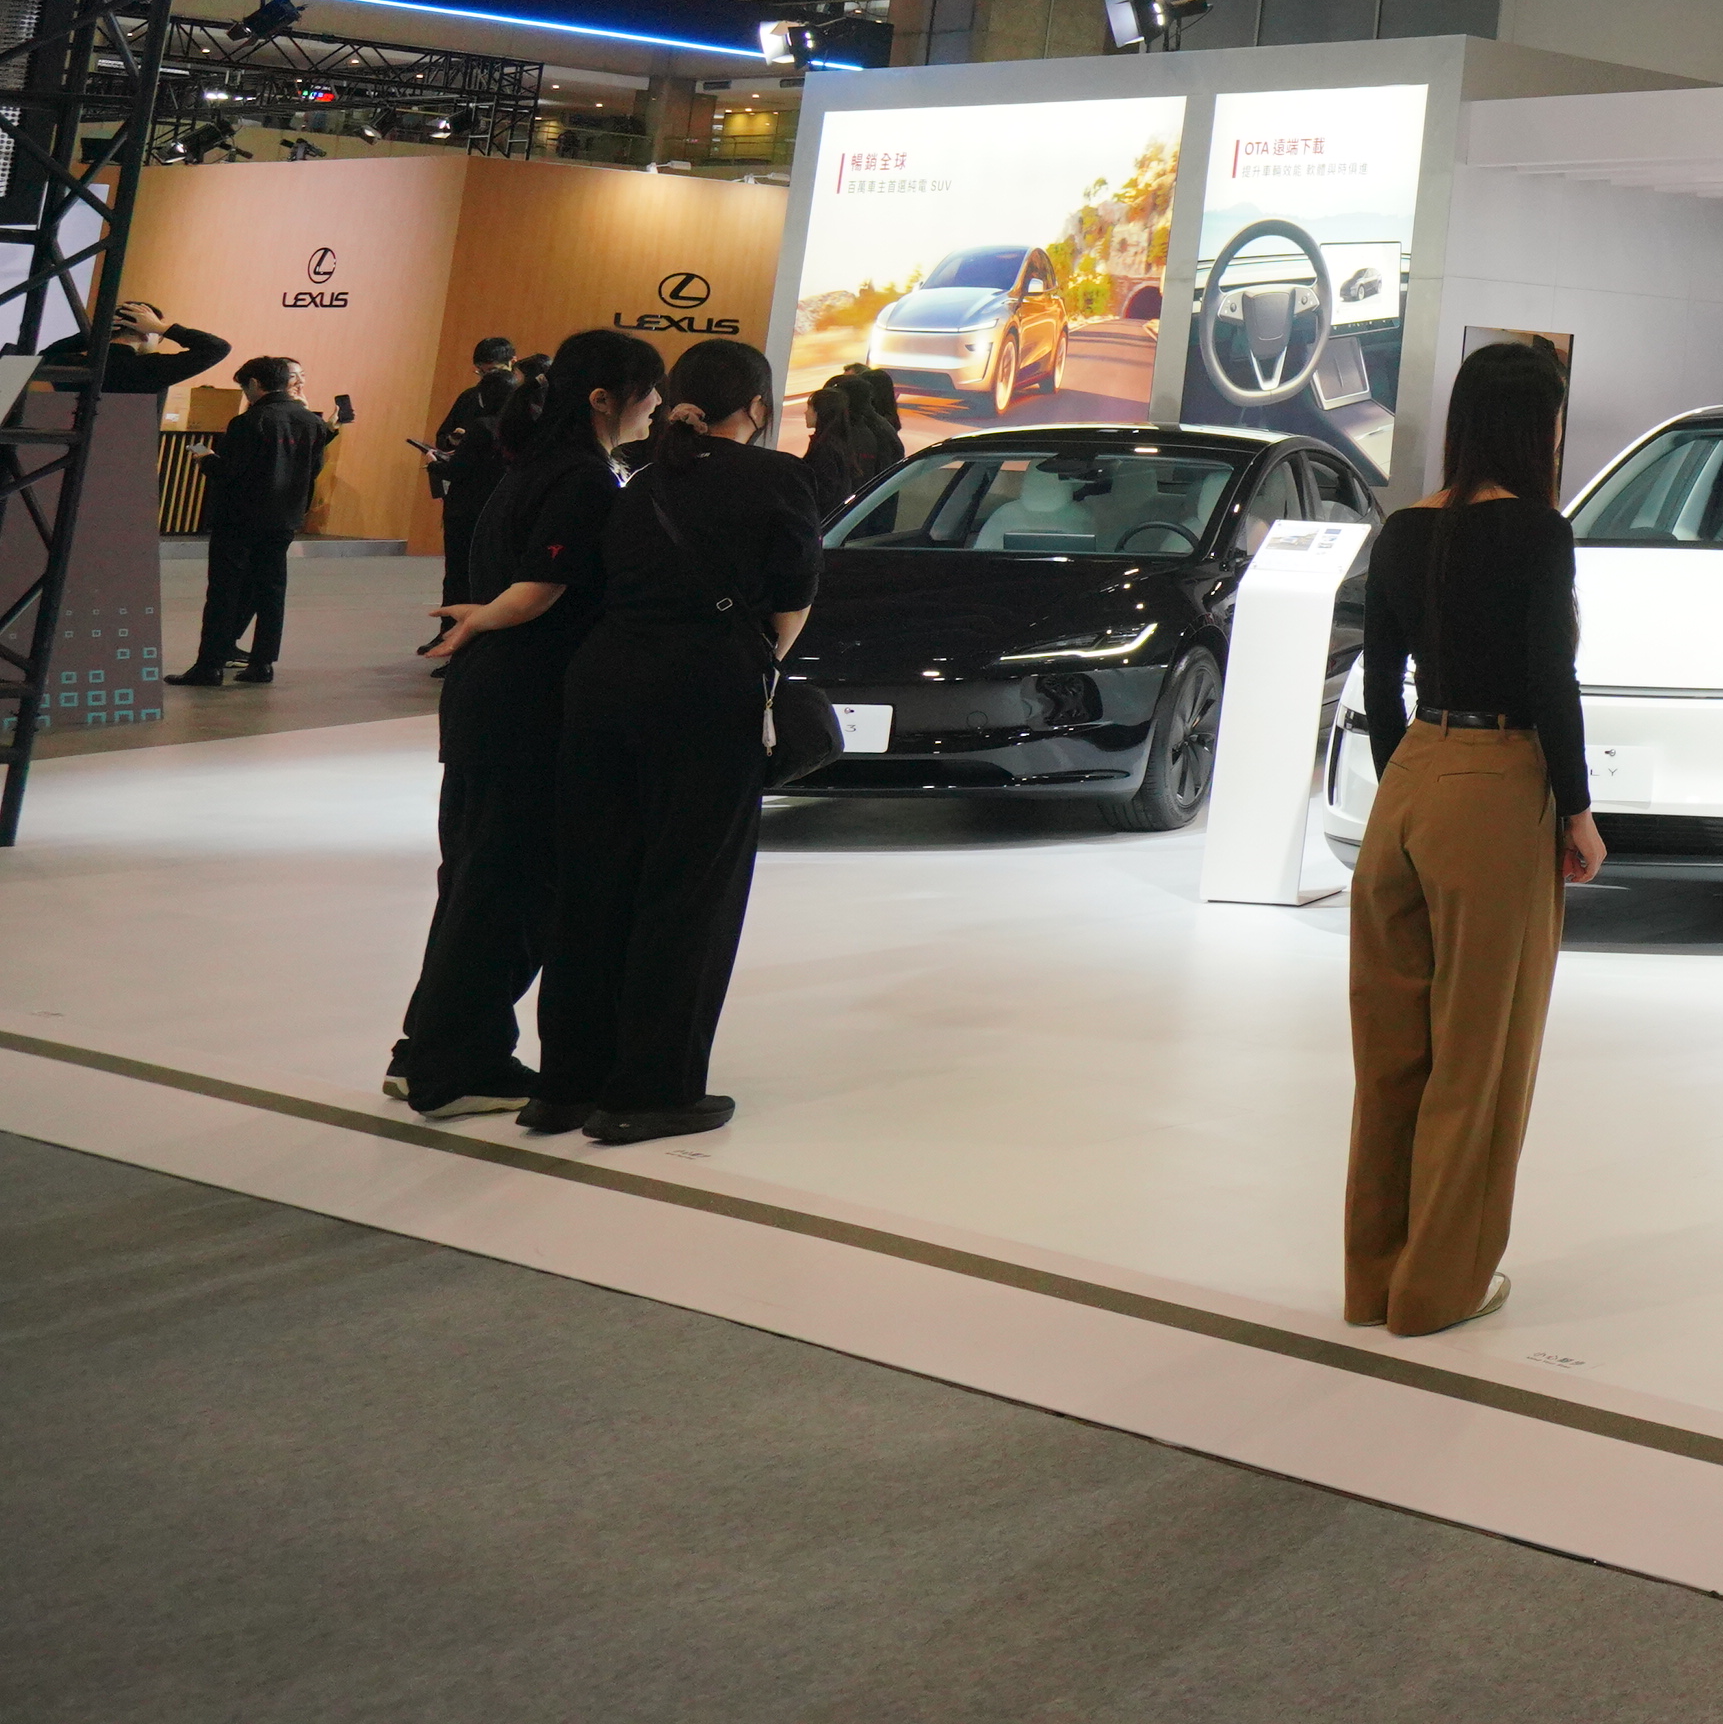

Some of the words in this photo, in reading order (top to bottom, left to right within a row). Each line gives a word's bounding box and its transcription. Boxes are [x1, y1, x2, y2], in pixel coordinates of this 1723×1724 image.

[1244, 141, 1269, 156] OTA
[1273, 137, 1326, 156] 遠端下載
[850, 152, 907, 172] 暢銷全球
[930, 180, 952, 192] SUV
[282, 292, 349, 309] LEXUS
[613, 312, 740, 335] LEXUS
[1608, 768, 1618, 776] Y
